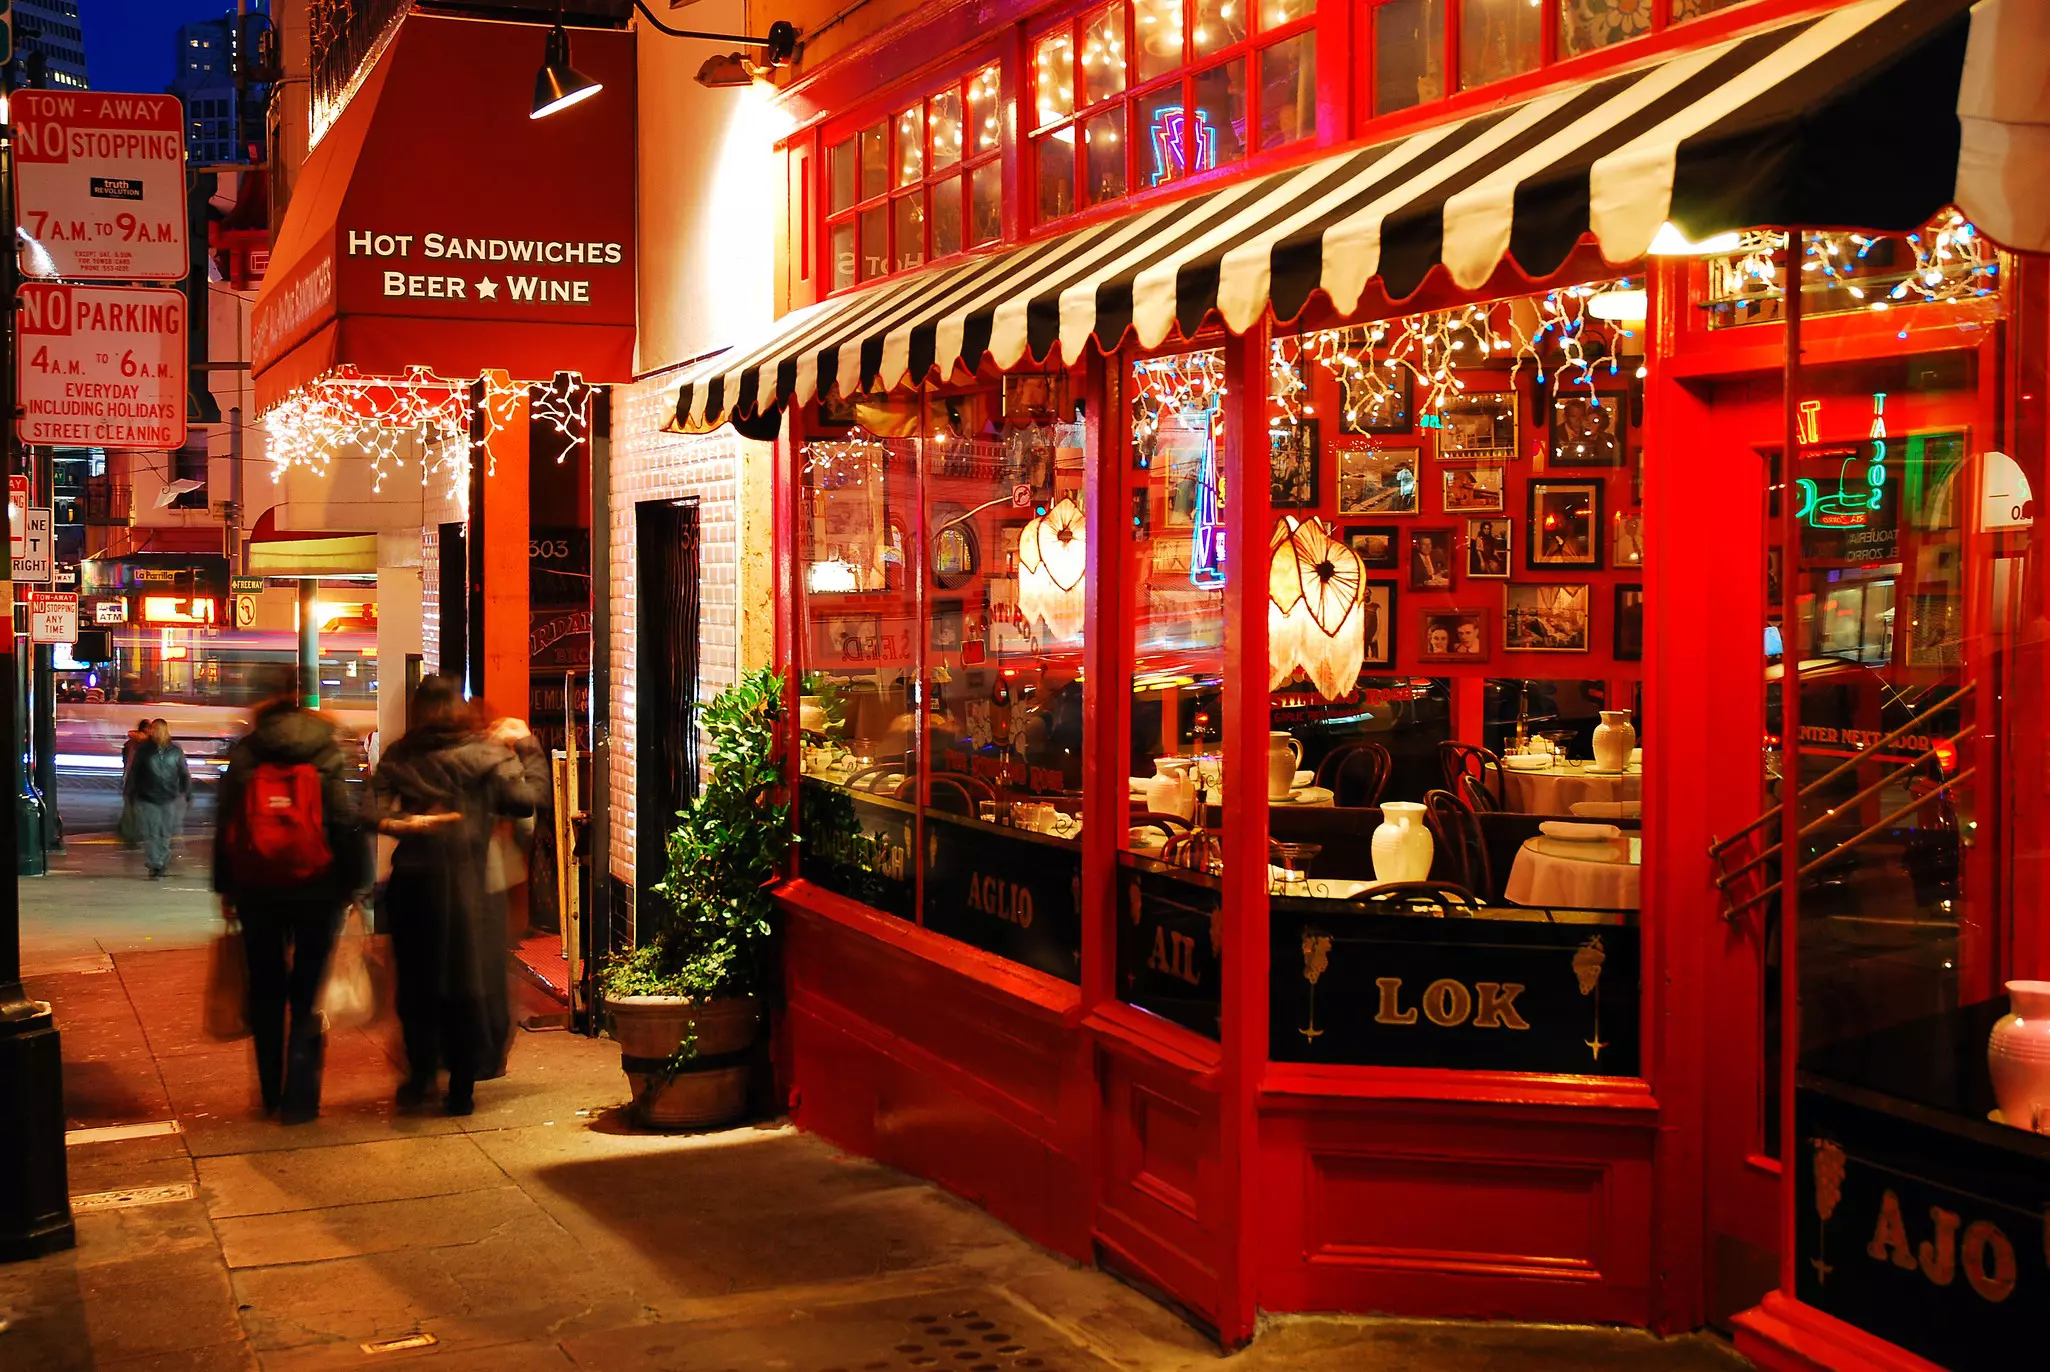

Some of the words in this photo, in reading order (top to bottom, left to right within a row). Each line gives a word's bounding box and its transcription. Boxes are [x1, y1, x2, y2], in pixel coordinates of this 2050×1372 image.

[99, 100, 164, 121] AWAY
[18, 122, 65, 157] NO
[72, 132, 177, 161] STOPPING
[94, 187, 140, 196] REVOLUTION
[104, 179, 129, 189] truth
[95, 223, 113, 236] TO
[348, 230, 413, 257] HOT
[424, 234, 622, 264] SANDWICHES
[383, 271, 467, 299] BEER
[507, 275, 590, 303] WINE
[24, 290, 66, 330] NO
[77, 301, 179, 334] PARKING
[96, 353, 109, 364] TO
[66, 382, 140, 399] EVERYDAY
[29, 399, 104, 417] INCLUDING
[107, 402, 175, 418] HOLIDAYS
[34, 422, 91, 439] STREET
[96, 424, 171, 441] CLEANING
[13, 559, 47, 572] RIGHT
[135, 571, 145, 580] La
[146, 571, 173, 580] Parrilla
[237, 580, 264, 589] FREEWAY
[34, 601, 45, 612] NO
[46, 604, 74, 614] STOPPING
[45, 615, 63, 624] ANY
[99, 613, 122, 621] ATM
[45, 625, 64, 634] TIME
[1841, 729, 1881, 747] NEXT
[967, 871, 1033, 928] AGLIO
[1148, 925, 1200, 985] AIL
[1375, 977, 1530, 1030] LOK
[1867, 1188, 2017, 1303] AJO
